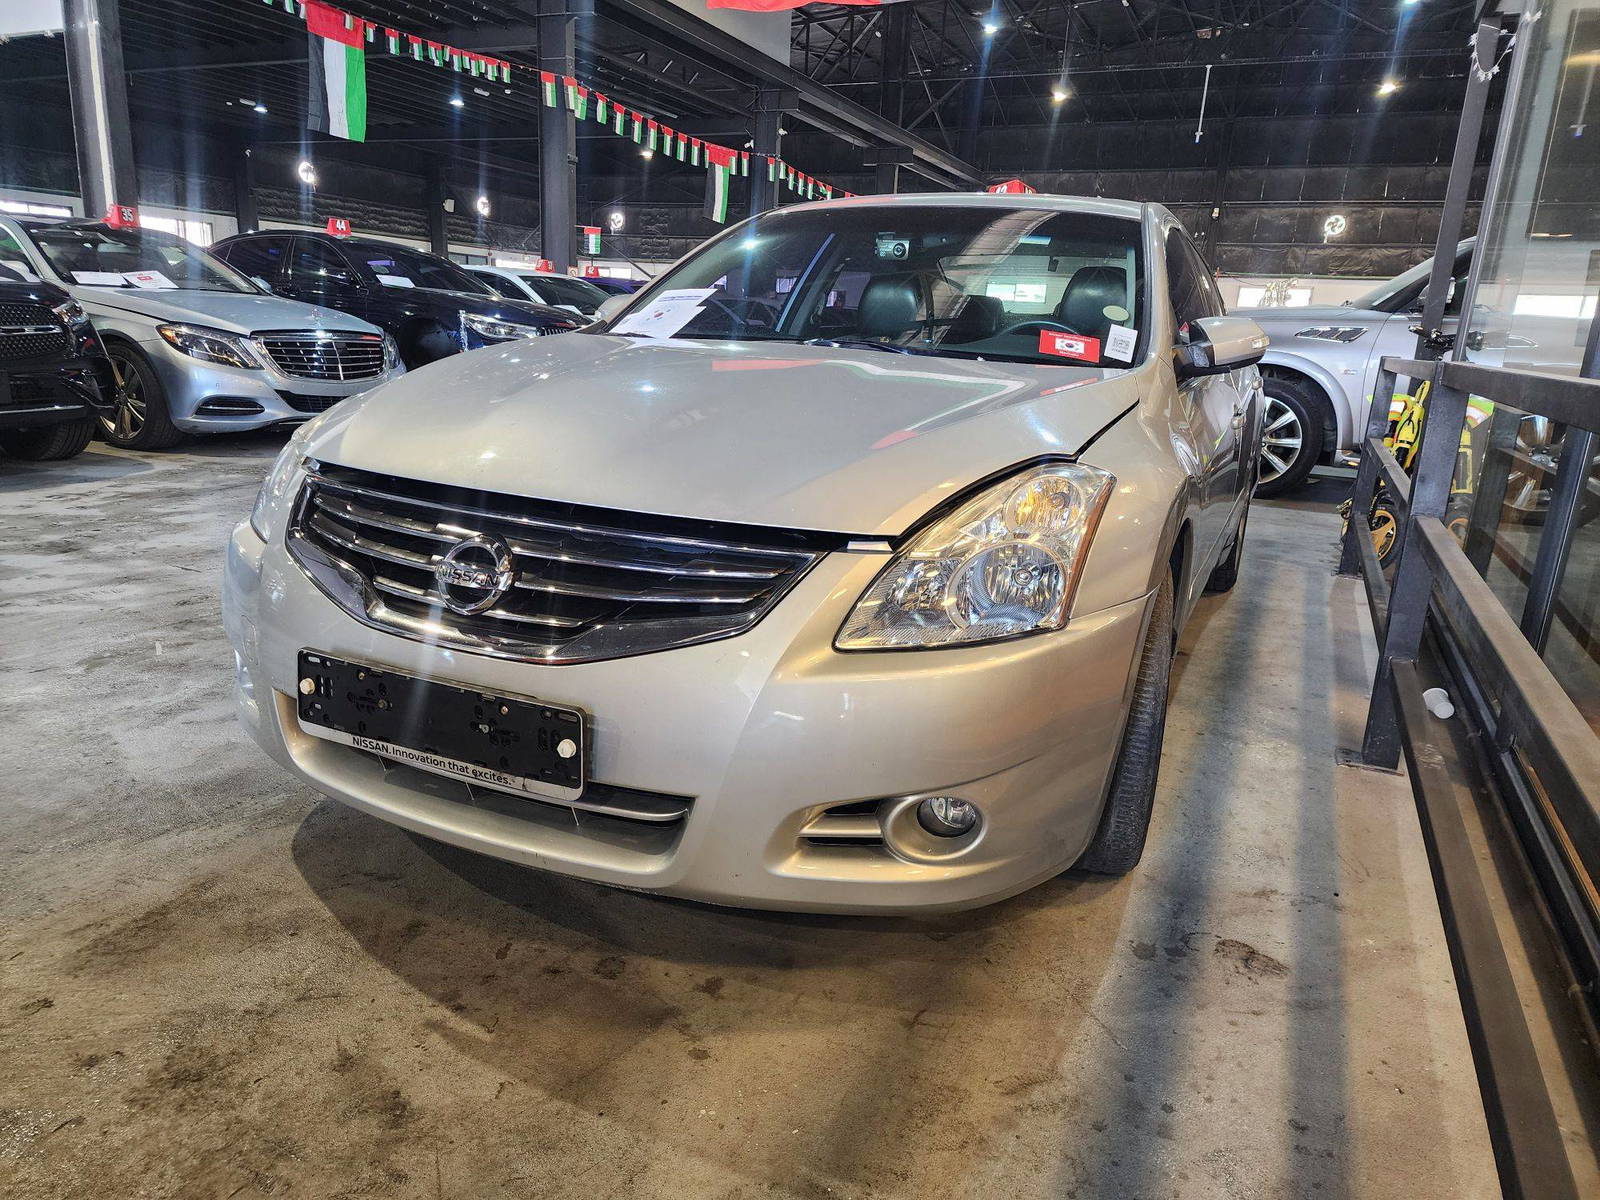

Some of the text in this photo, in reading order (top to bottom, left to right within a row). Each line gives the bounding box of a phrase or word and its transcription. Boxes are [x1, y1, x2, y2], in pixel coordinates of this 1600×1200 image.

[121, 207, 134, 222] 35
[336, 219, 346, 231] 44
[438, 566, 499, 588] NISSAN
[447, 760, 470, 775] that
[471, 768, 512, 786] excites.
